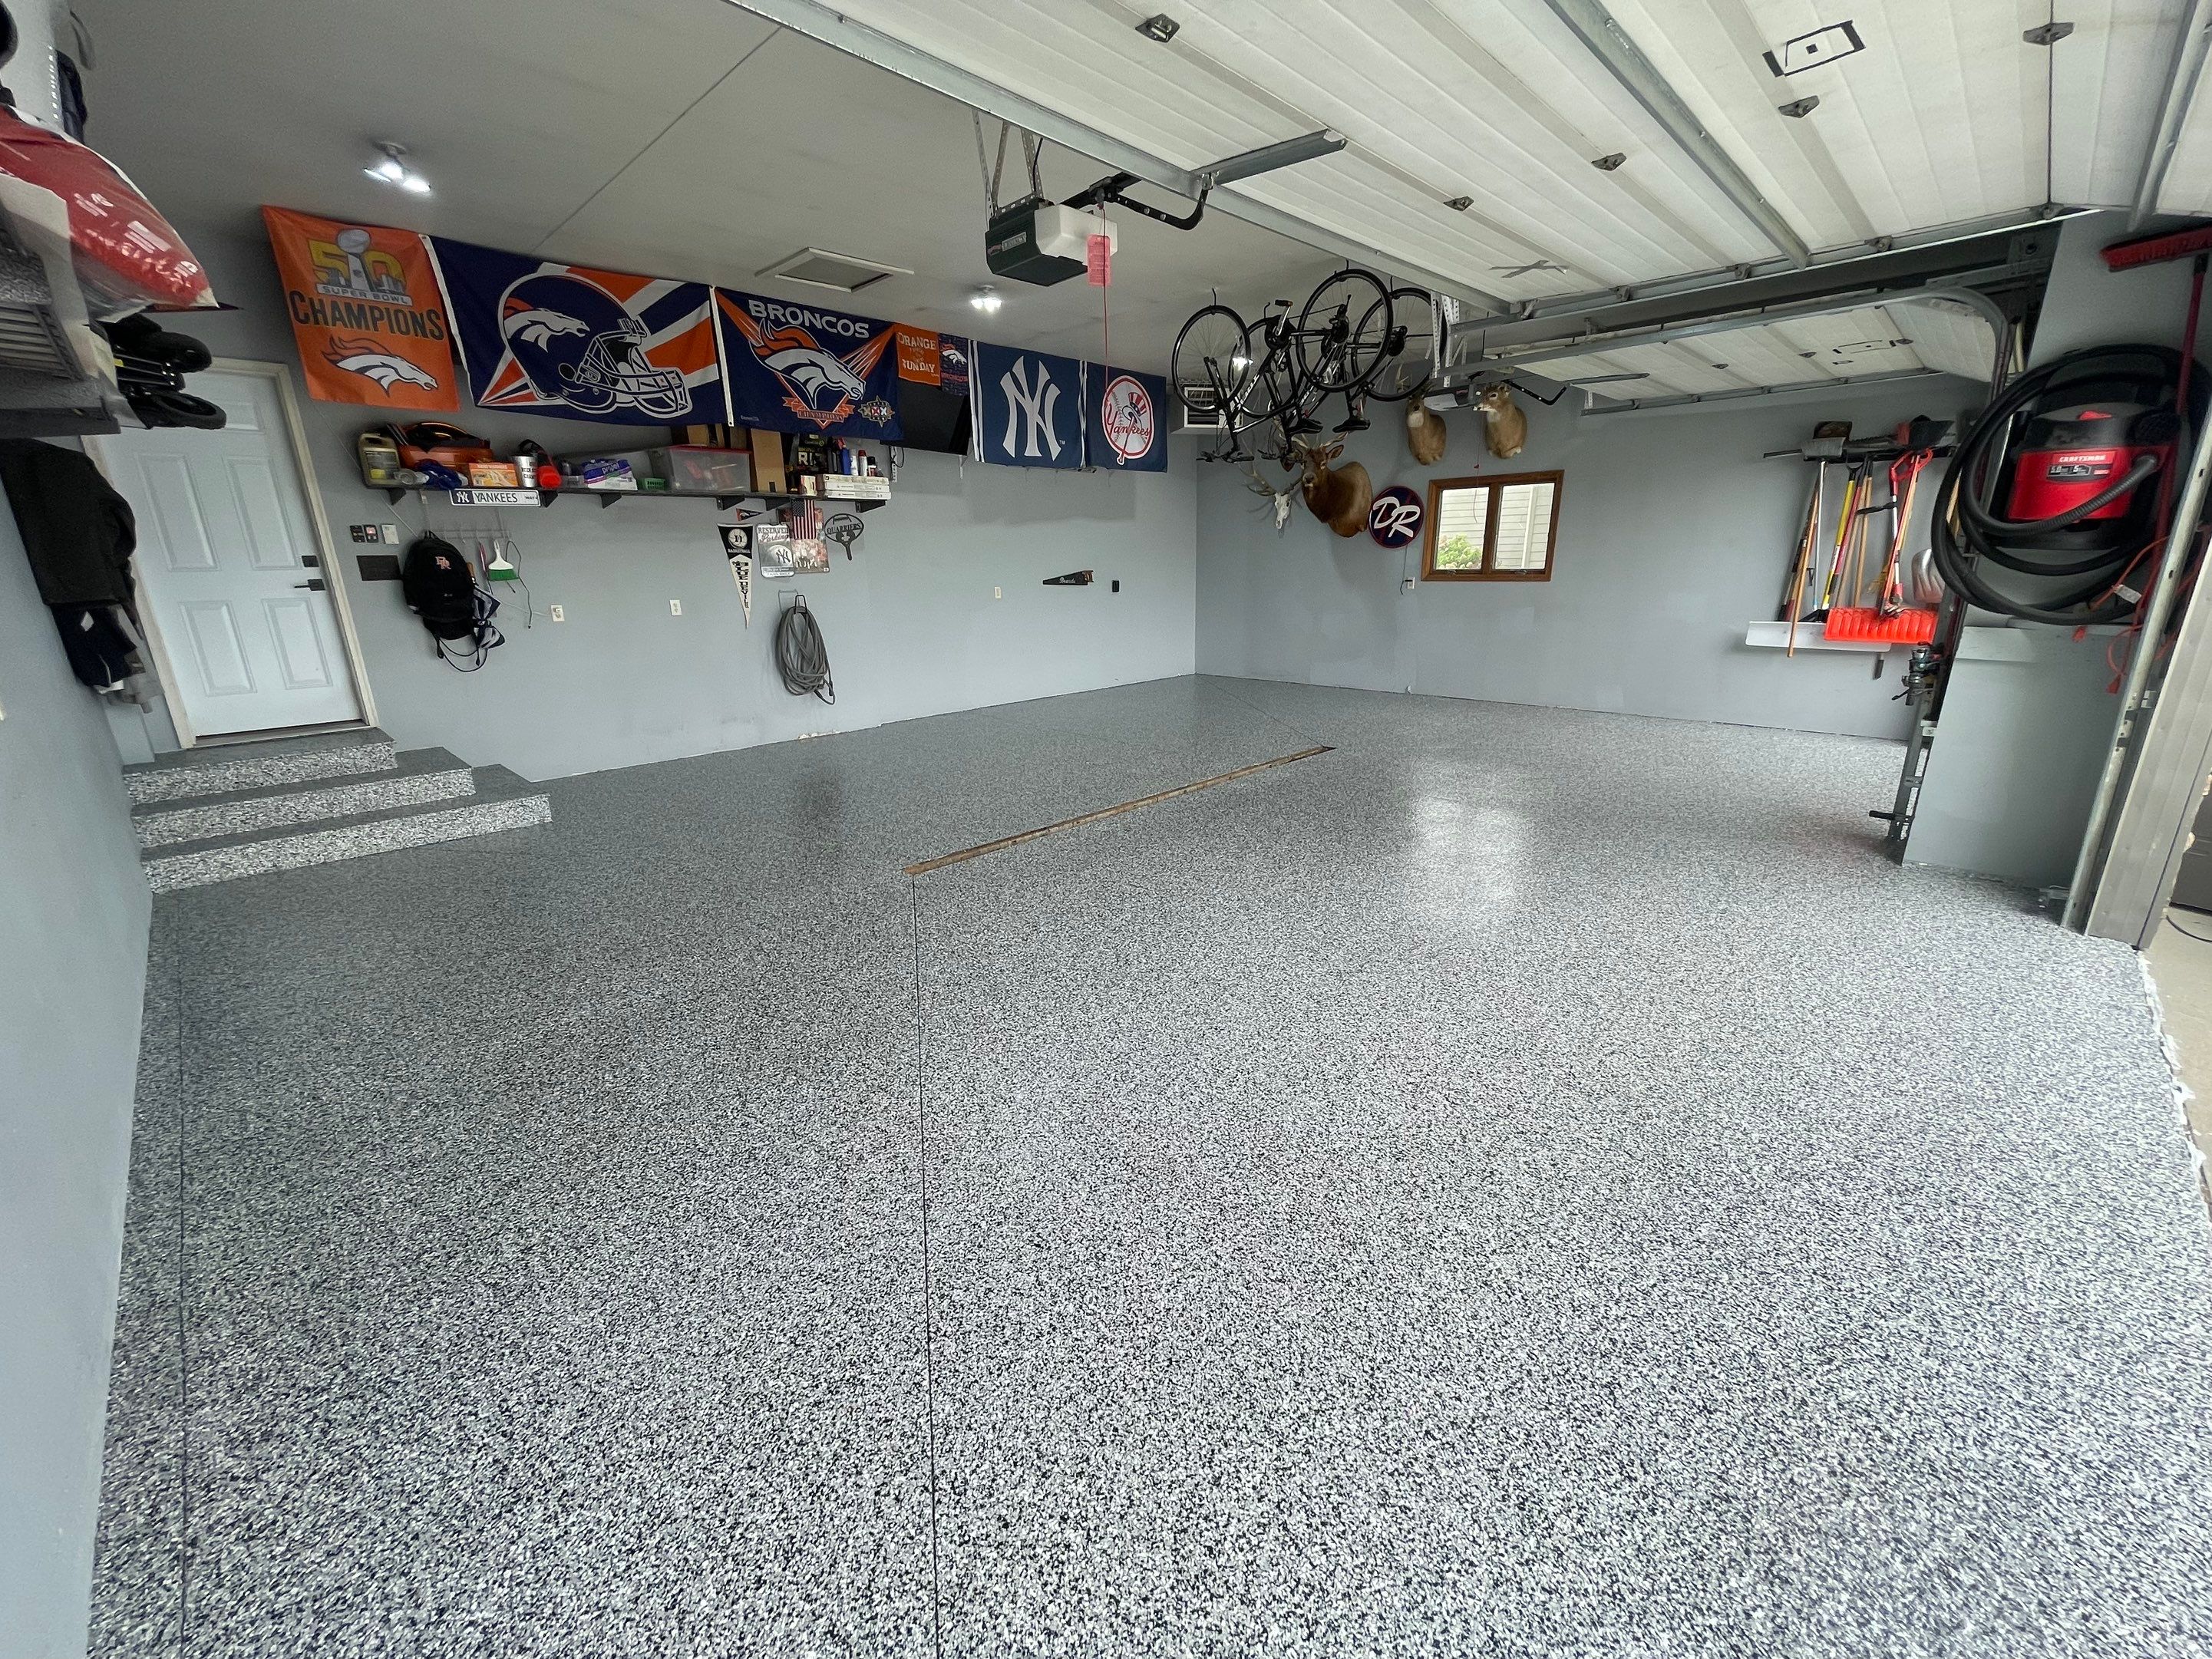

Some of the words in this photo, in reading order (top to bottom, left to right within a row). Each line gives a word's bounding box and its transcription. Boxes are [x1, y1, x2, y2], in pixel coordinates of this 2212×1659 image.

[322, 285, 368, 298] SUPER
[373, 292, 408, 304] BOWL
[289, 290, 445, 341] CHAMPIONS
[748, 299, 870, 338] BRONCOS
[896, 332, 936, 350] ORANGE
[1104, 398, 1151, 440] Yankees
[474, 493, 518, 503] YANKEES
[1372, 496, 1421, 538] DR
[758, 526, 789, 535] RESERVED
[827, 523, 861, 535] QUARRIERS
